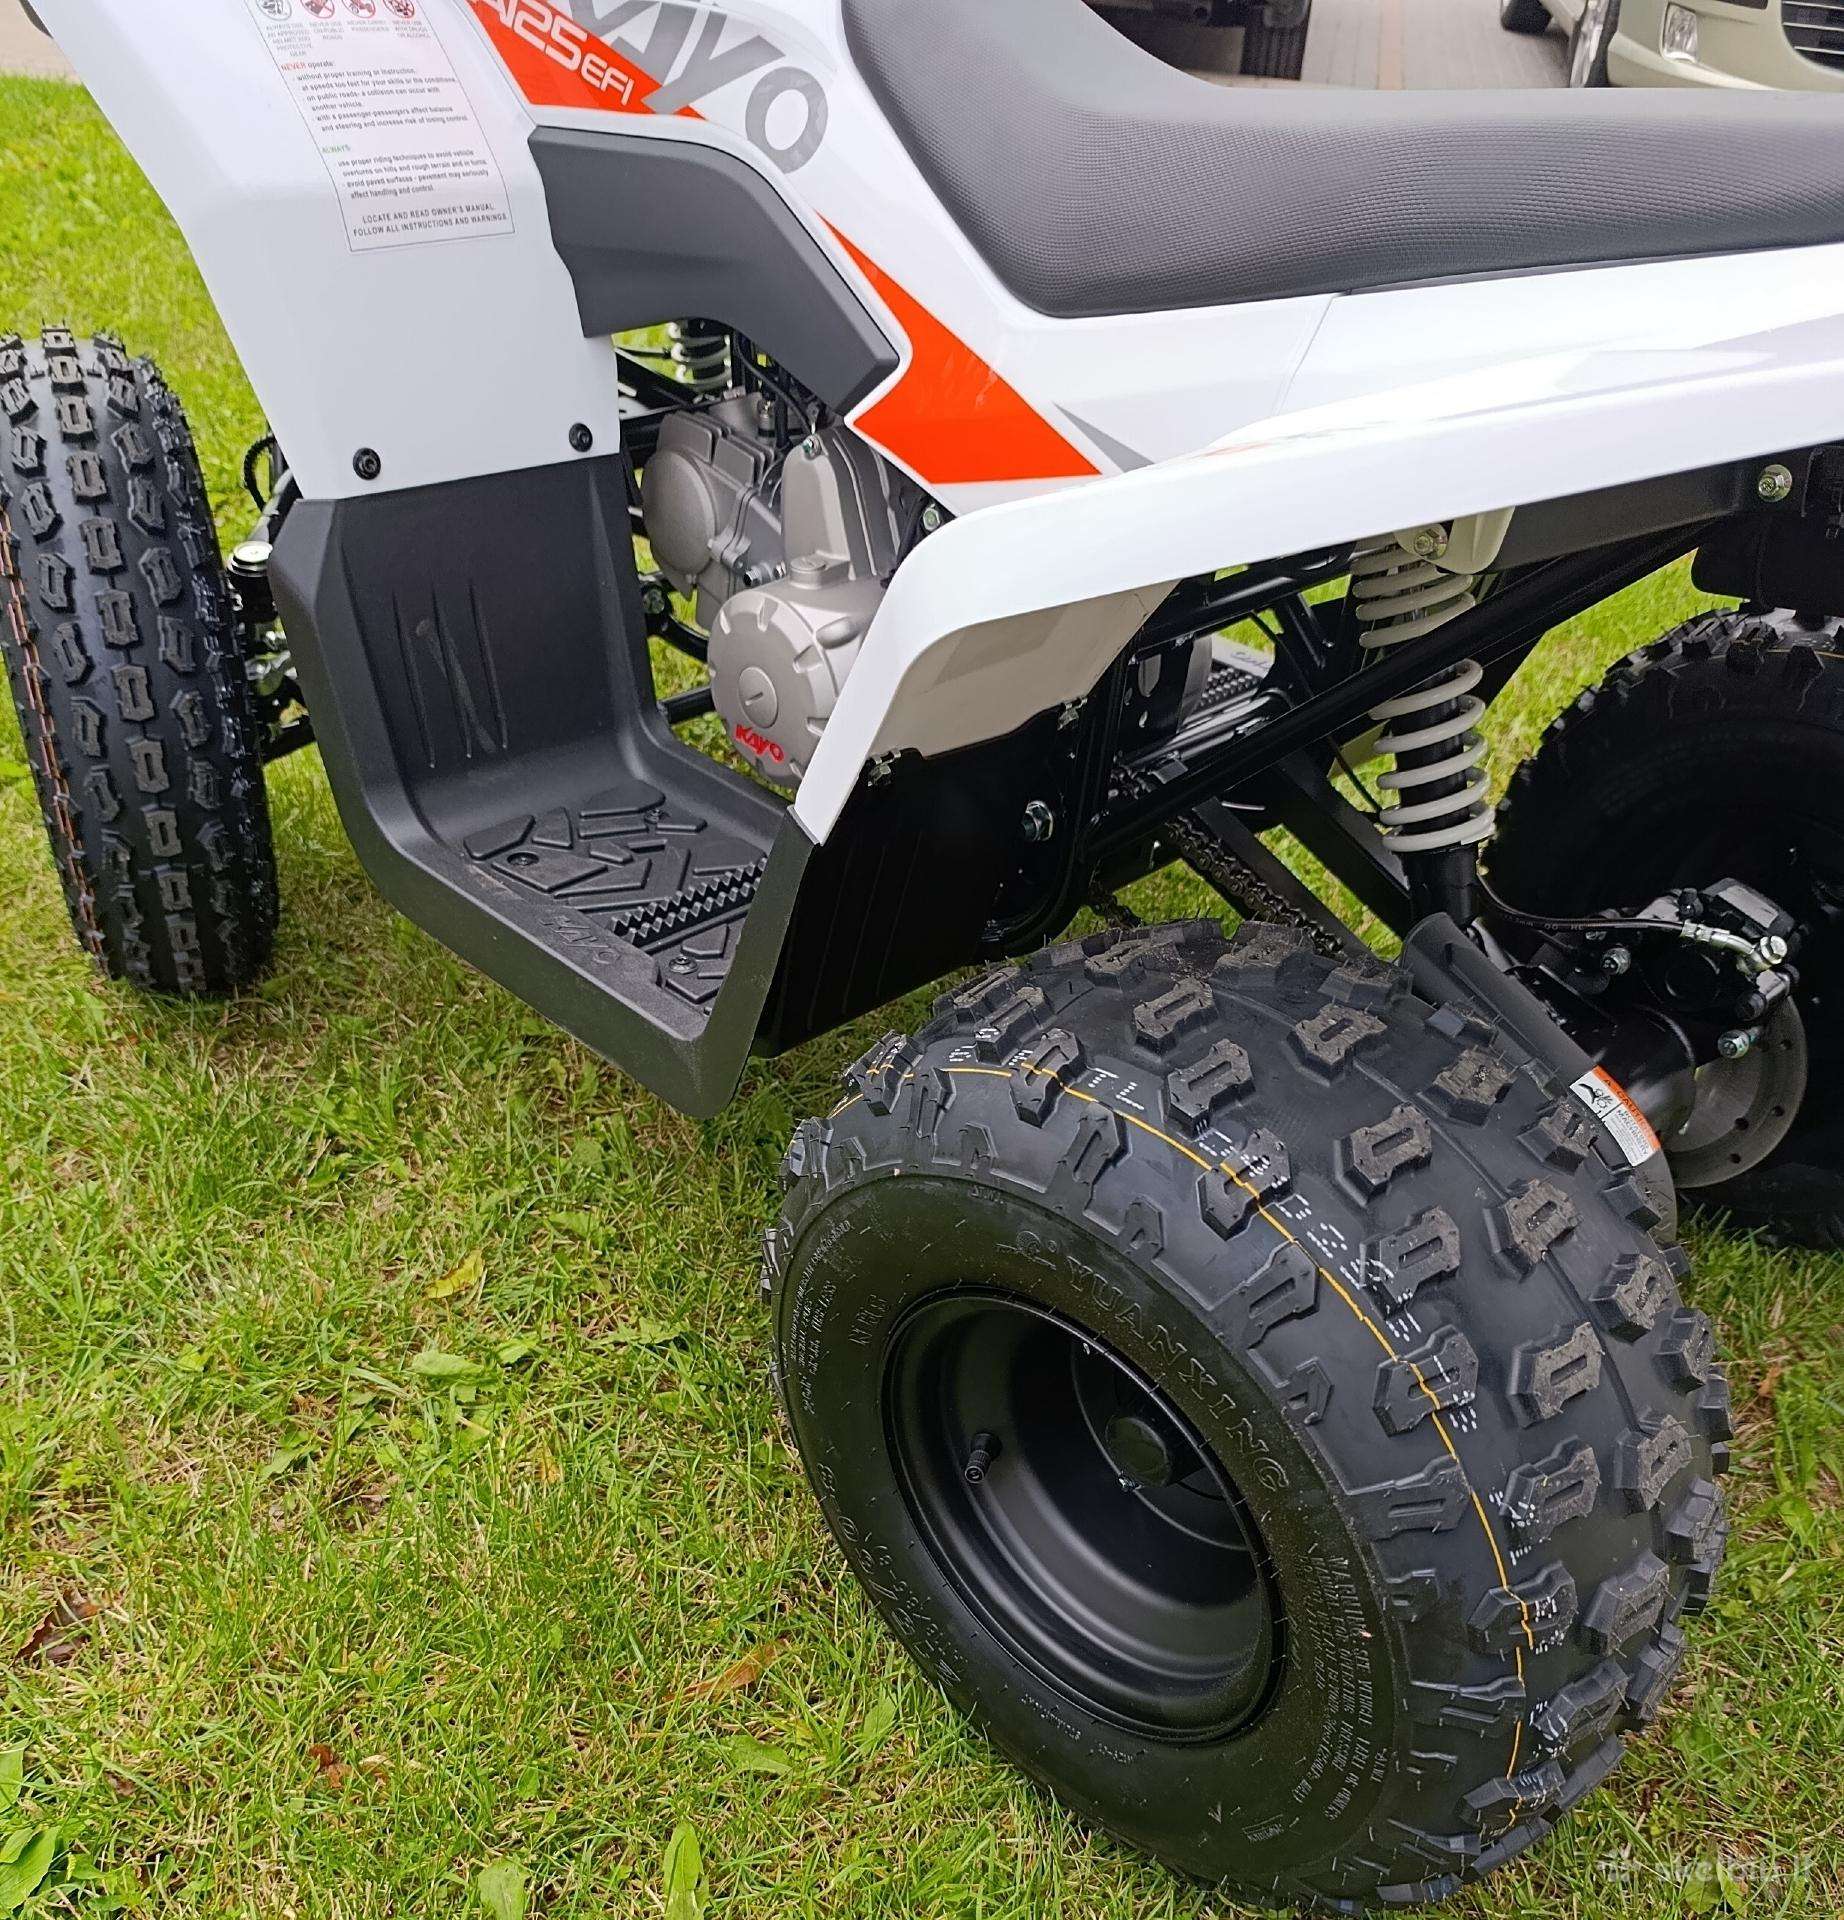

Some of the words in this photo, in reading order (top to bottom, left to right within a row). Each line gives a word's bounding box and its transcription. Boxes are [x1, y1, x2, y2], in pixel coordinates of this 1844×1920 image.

[281, 61, 306, 71] NEVER
[297, 72, 322, 81] without
[323, 71, 345, 80] proper
[346, 69, 373, 78] training
[302, 83, 309, 91] at
[310, 81, 334, 92] speeds
[347, 80, 360, 88] fast
[361, 79, 371, 87] for
[372, 79, 386, 88] your
[306, 94, 316, 102] on
[317, 92, 338, 102] public
[367, 88, 394, 96] collision
[311, 102, 337, 112] another
[317, 112, 330, 121] with
[411, 106, 428, 114] affect
[428, 105, 453, 113] balance
[321, 123, 334, 132] and
[335, 121, 363, 131] steering
[363, 119, 376, 127] and
[377, 118, 403, 127] increase
[404, 117, 417, 125] risk
[425, 115, 446, 124] losing
[337, 159, 350, 168] use
[350, 157, 372, 168] proper
[372, 155, 393, 164] riding
[392, 152, 426, 162] techniques
[435, 149, 452, 158] avoid
[453, 148, 474, 157] vehicle
[342, 167, 374, 177] overturns
[384, 164, 397, 173] hills
[398, 163, 411, 171] and
[411, 162, 430, 171] rough
[430, 160, 451, 169] terrain
[451, 159, 464, 168] and
[347, 178, 365, 188] avoid
[365, 176, 386, 187] paved
[386, 174, 413, 184] surfaces
[417, 171, 447, 182] pavement
[448, 170, 462, 180] may
[461, 168, 489, 178] seriously
[350, 189, 370, 200] affect
[369, 186, 398, 198] handling
[398, 185, 411, 195] and
[362, 212, 392, 224] LOCATE
[393, 210, 409, 220] AND
[410, 207, 430, 218] READ
[431, 204, 464, 216] OWNER'S
[353, 225, 385, 237] FOLLOW
[386, 222, 400, 233] ALL
[401, 217, 453, 231] INSTRUCTIONS
[455, 215, 470, 225] AND
[735, 723, 785, 761] KAYO
